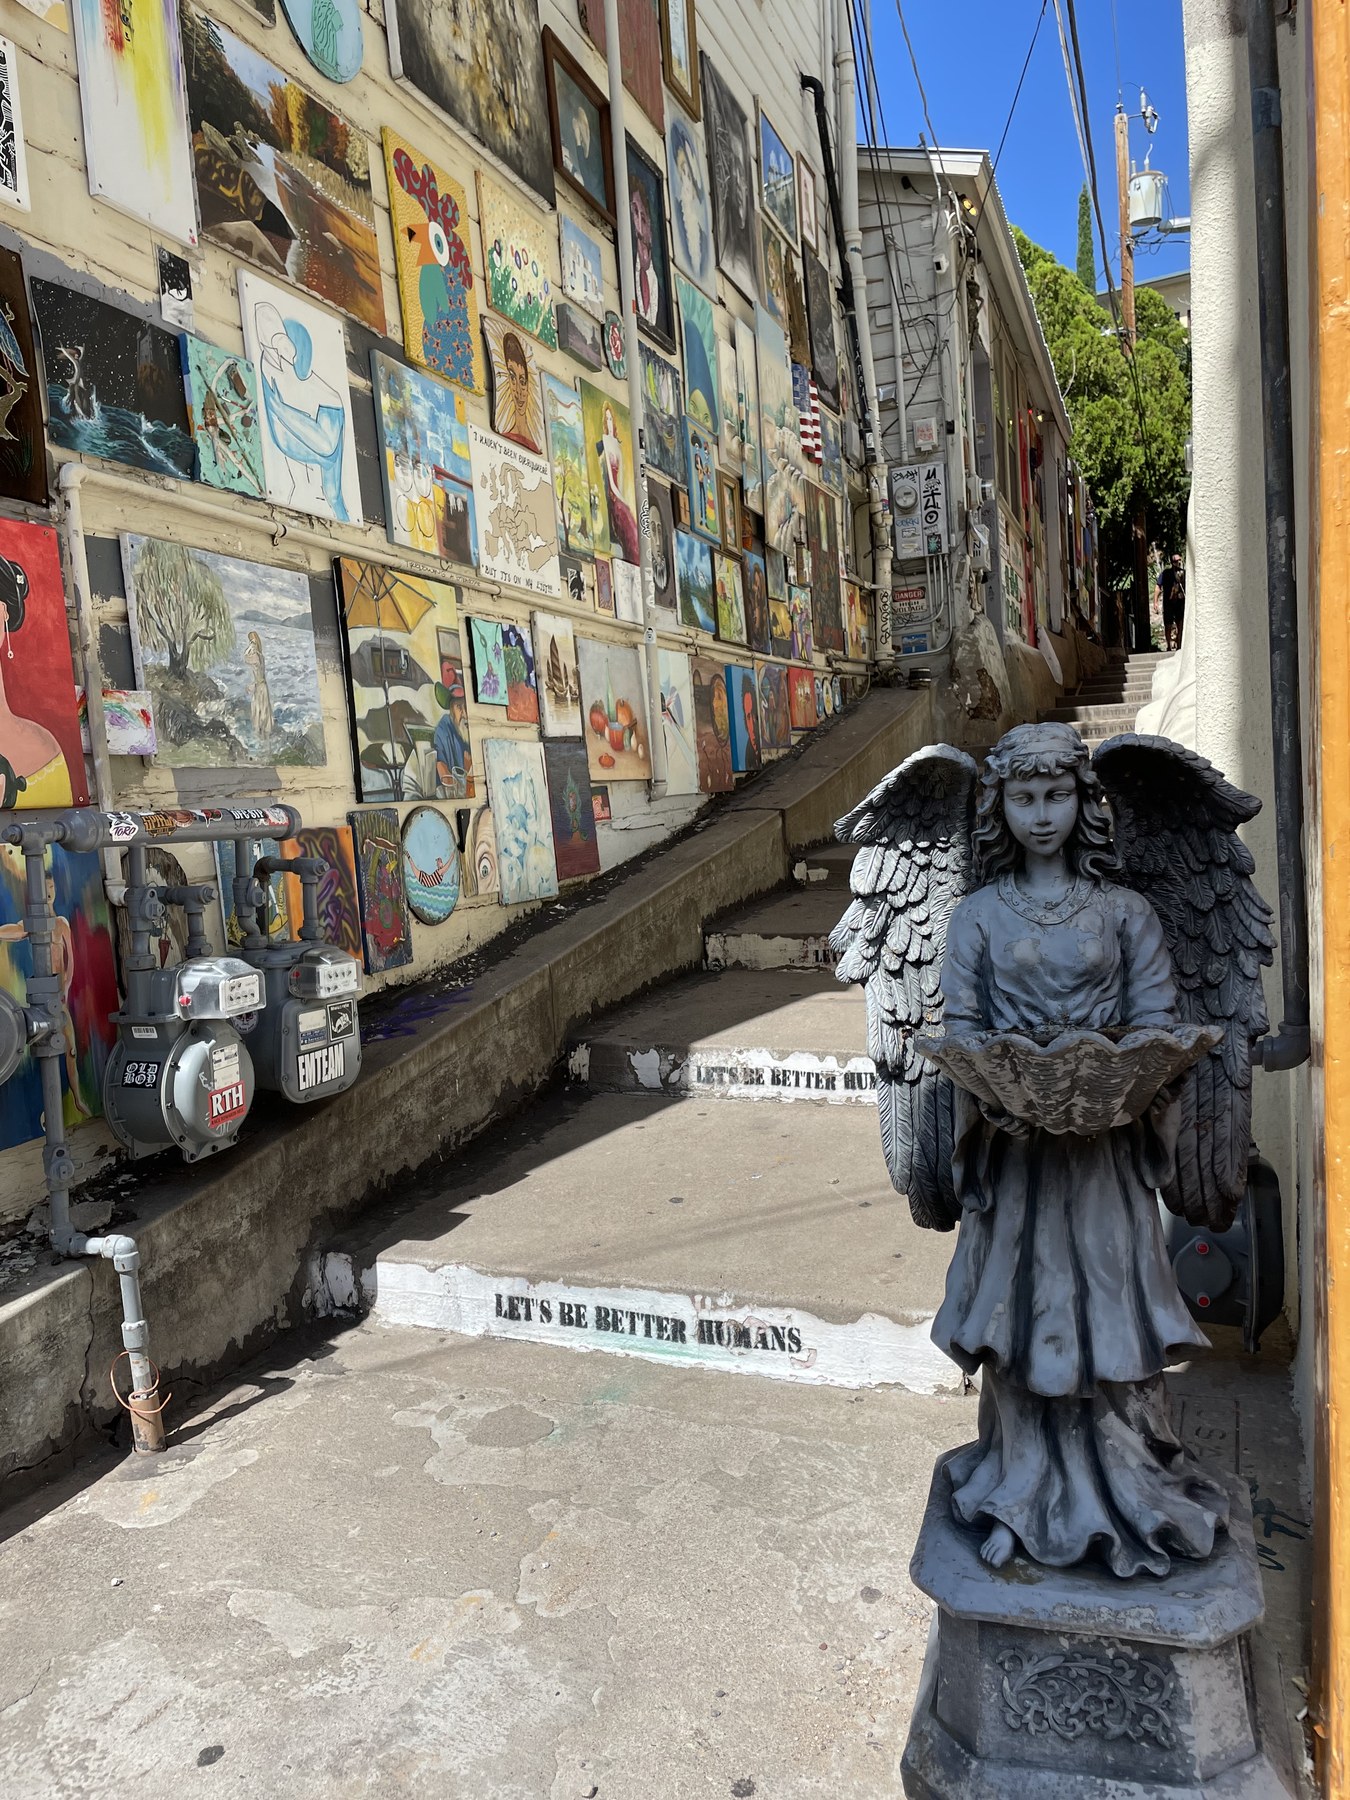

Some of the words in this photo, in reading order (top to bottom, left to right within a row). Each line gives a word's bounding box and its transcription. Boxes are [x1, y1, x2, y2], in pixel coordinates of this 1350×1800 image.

[503, 446, 518, 460] BEEN
[485, 565, 497, 578] BUT
[513, 574, 521, 585] ON
[895, 590, 923, 600] DANGER
[113, 826, 136, 836] TORO
[126, 1062, 158, 1075] OLD
[297, 1042, 345, 1091] EMTEAM
[123, 1072, 156, 1087] BOY
[743, 1067, 765, 1086] BE
[770, 1069, 837, 1091] BETTER
[211, 1084, 244, 1117] RTH
[495, 1293, 552, 1324] LET'S
[559, 1301, 588, 1329] BE
[595, 1305, 687, 1344] BETTER
[698, 1318, 802, 1354] HUMANS
